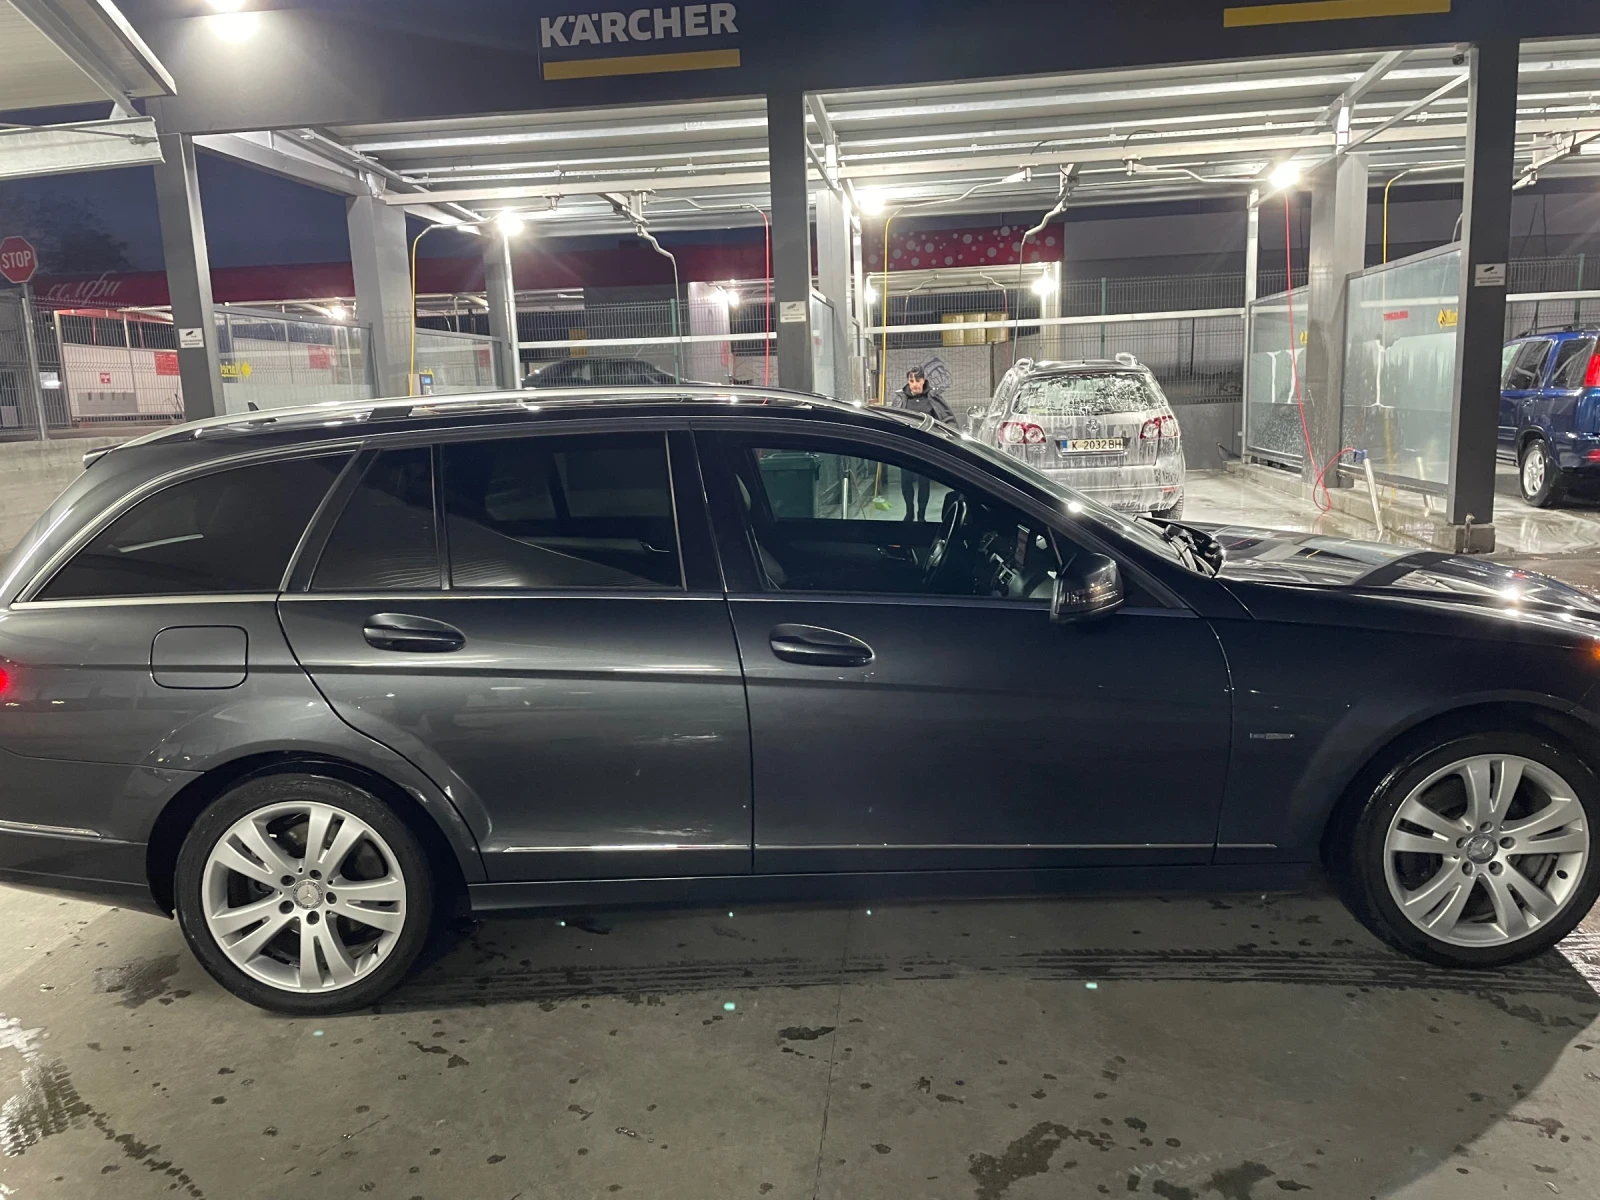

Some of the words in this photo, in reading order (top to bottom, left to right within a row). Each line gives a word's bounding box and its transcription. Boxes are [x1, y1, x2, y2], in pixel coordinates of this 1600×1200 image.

[540, 2, 739, 48] KÄRCHER
[1, 250, 32, 269] STOP
[1072, 441, 1078, 450] K
[1083, 440, 1107, 450] 2032
[1108, 439, 1122, 449] BH
